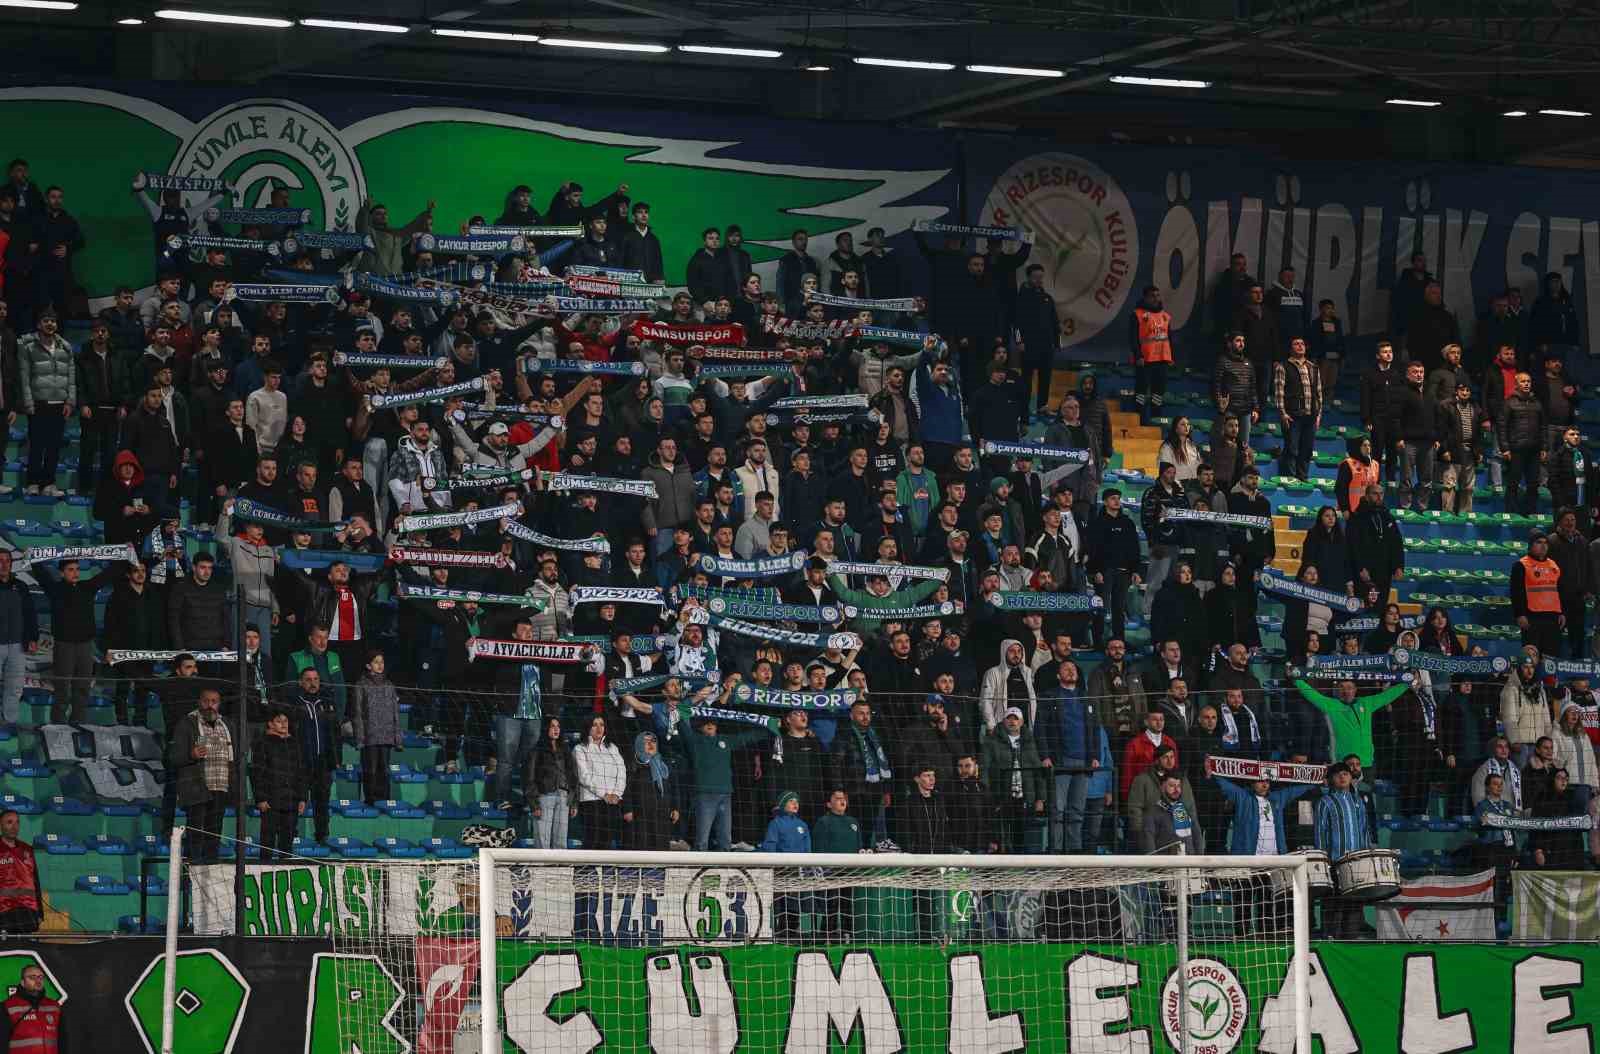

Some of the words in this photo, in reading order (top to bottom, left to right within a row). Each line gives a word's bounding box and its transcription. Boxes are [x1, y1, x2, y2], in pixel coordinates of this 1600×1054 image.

[150, 175, 224, 191] RİZESPOR
[438, 240, 470, 251] ÇAYKUR
[641, 326, 731, 341] SAMSUNSPOR
[718, 557, 756, 572] CÜMLE
[753, 688, 842, 707] RİZESPOR
[1215, 759, 1247, 776] KING
[1293, 767, 1325, 783] NORTH
[697, 875, 750, 942] 53
[503, 951, 1152, 1054] CÜMLE
[1167, 991, 1181, 1040] AYKUR
